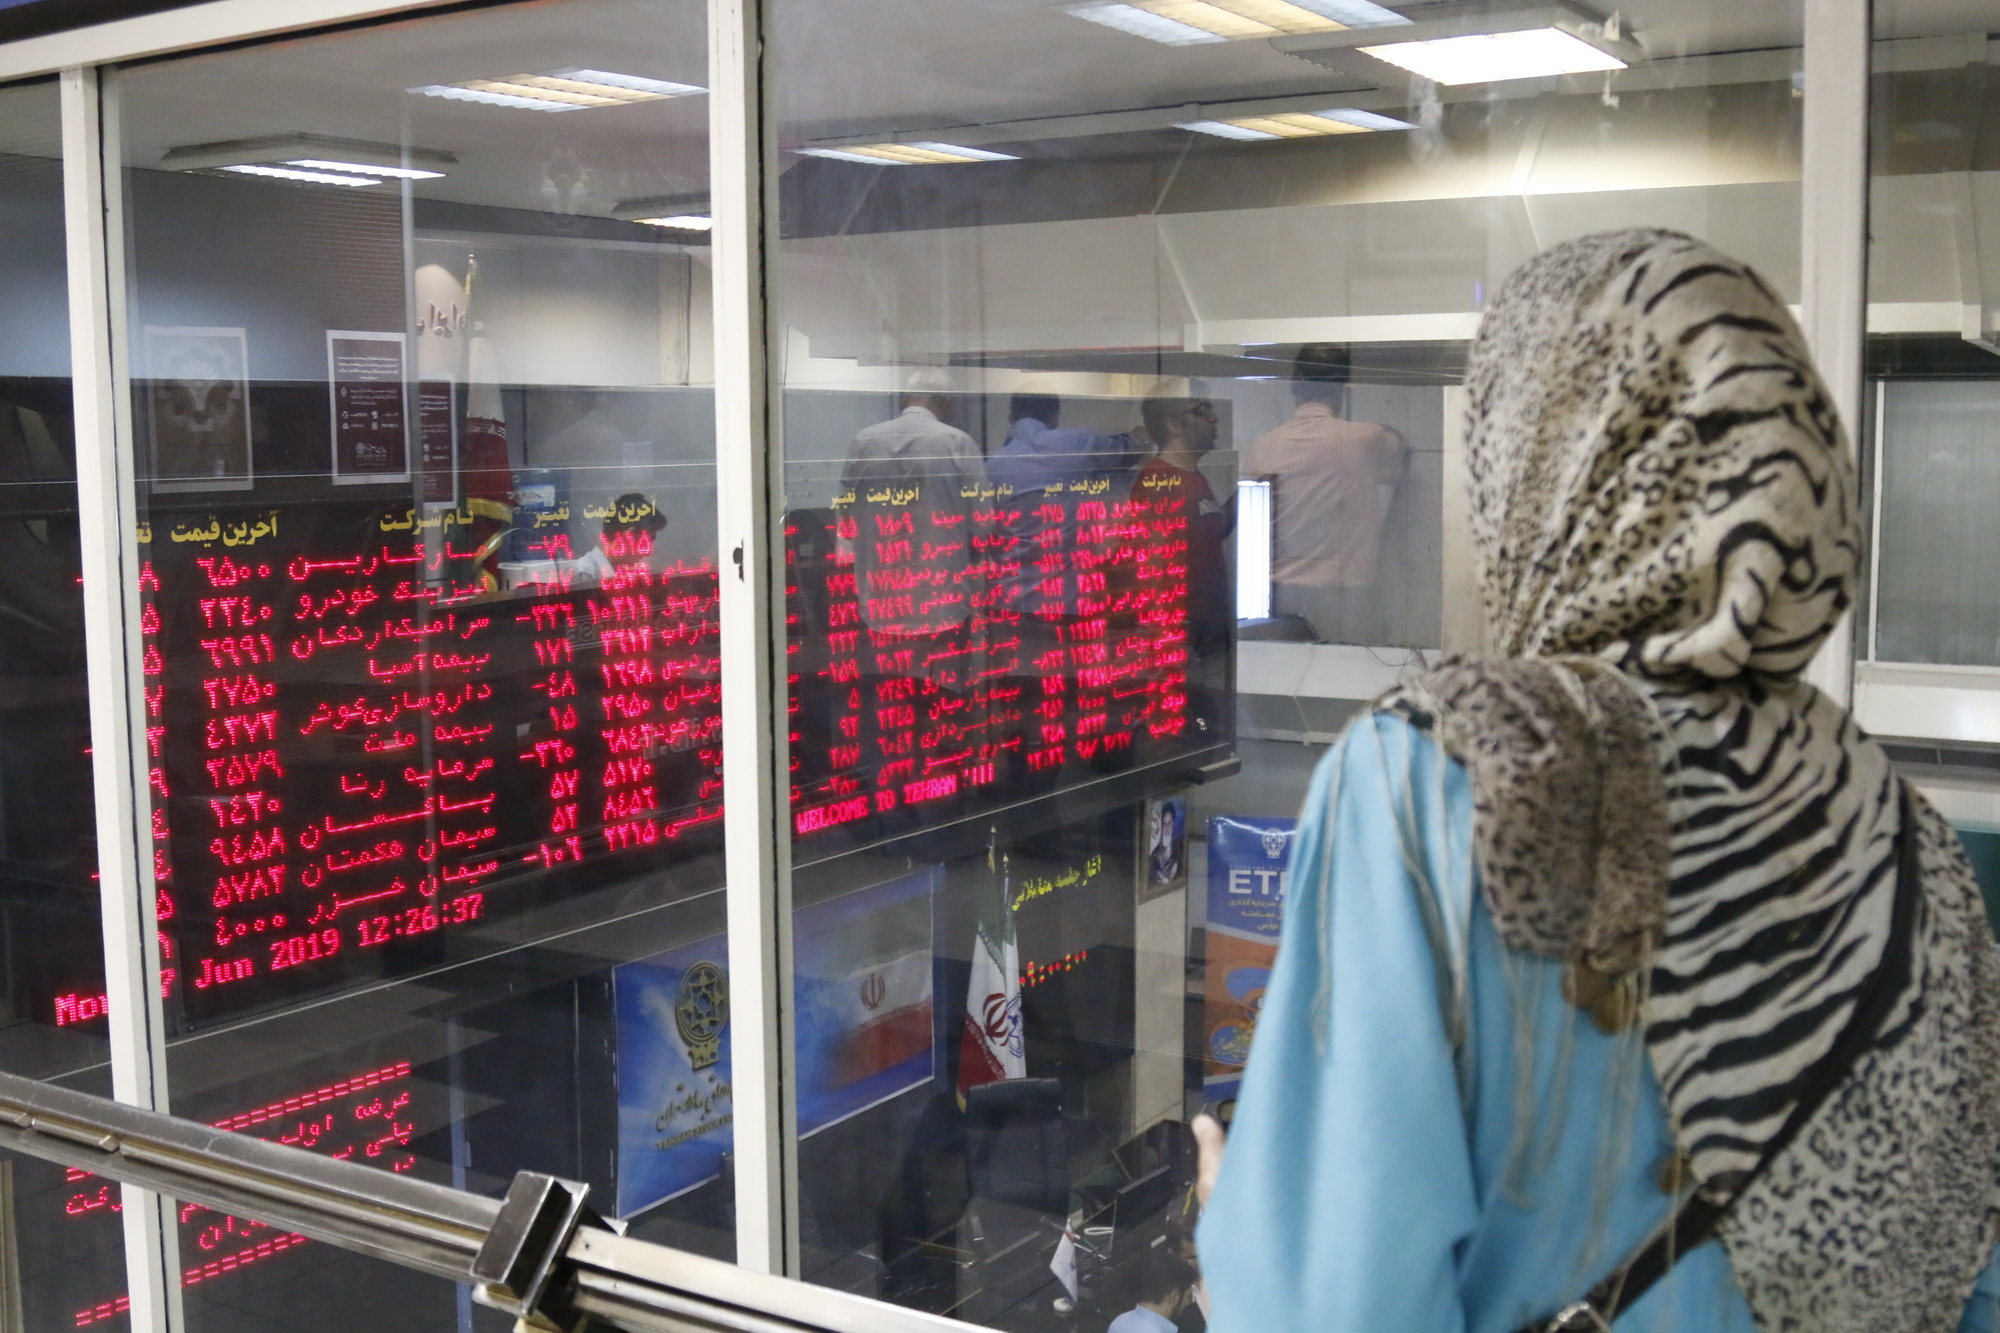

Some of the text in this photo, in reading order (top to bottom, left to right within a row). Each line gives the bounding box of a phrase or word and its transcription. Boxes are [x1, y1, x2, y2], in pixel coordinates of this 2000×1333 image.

[223, 509, 280, 547] آخرین
[380, 505, 441, 535] شرکت
[443, 507, 475, 535] نام
[533, 501, 570, 529] تغییر
[170, 515, 221, 549] قیمت
[529, 530, 653, 560] ۱۵۱۵ -۷۹
[197, 556, 271, 587] ۶۵۰۰
[295, 585, 379, 620] خودرو
[200, 633, 274, 668] ۶۹۹۱
[432, 654, 490, 673] بیمه
[534, 638, 572, 664] ۱۷۱
[368, 653, 428, 683] آسیا
[532, 657, 654, 698] ۱۶۹۸ -۴۸
[550, 704, 577, 730] ۱۵
[364, 731, 417, 752] ملت
[434, 724, 493, 744] بیمه
[341, 773, 386, 799] رنا
[404, 758, 494, 788] سرمایه
[550, 754, 653, 800] ۵۱۷۰ ۵۷
[794, 794, 868, 833] WELCOME
[875, 790, 896, 811] TO
[904, 772, 958, 804] TEHRAN
[299, 791, 497, 851] پاکسان
[210, 827, 286, 866] ۹۴۵۸
[418, 828, 497, 862] سیمان
[418, 861, 498, 899] سیمان
[306, 874, 409, 927] خزر
[195, 958, 254, 988] Jun
[270, 928, 341, 970] 2019
[355, 890, 483, 946] 12:26:37
[216, 914, 289, 948] ۴۰۰۰
[354, 1092, 410, 1119] عرضه
